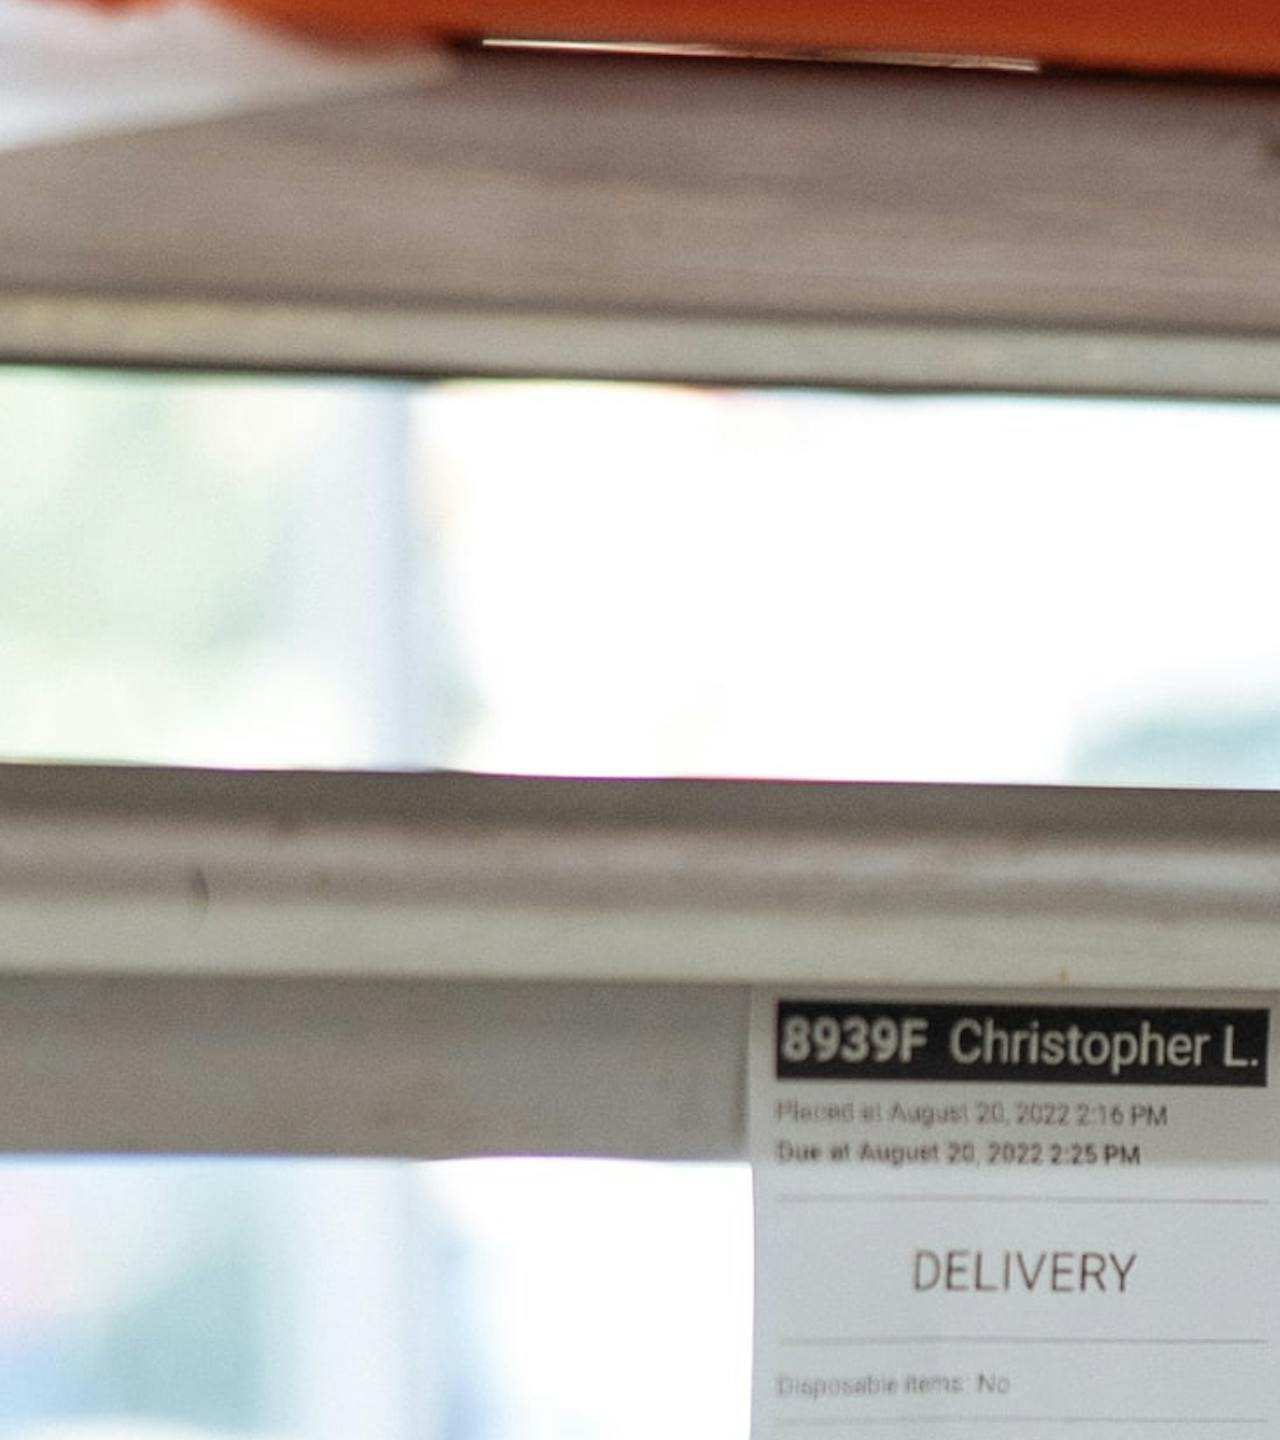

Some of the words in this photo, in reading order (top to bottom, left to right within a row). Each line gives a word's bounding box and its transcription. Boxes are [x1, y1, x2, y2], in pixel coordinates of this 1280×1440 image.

[780, 1017, 929, 1062] 8939F
[949, 1019, 1210, 1074] Christopher
[1224, 1026, 1258, 1067] L.
[913, 1250, 1137, 1293] DELIVERY
